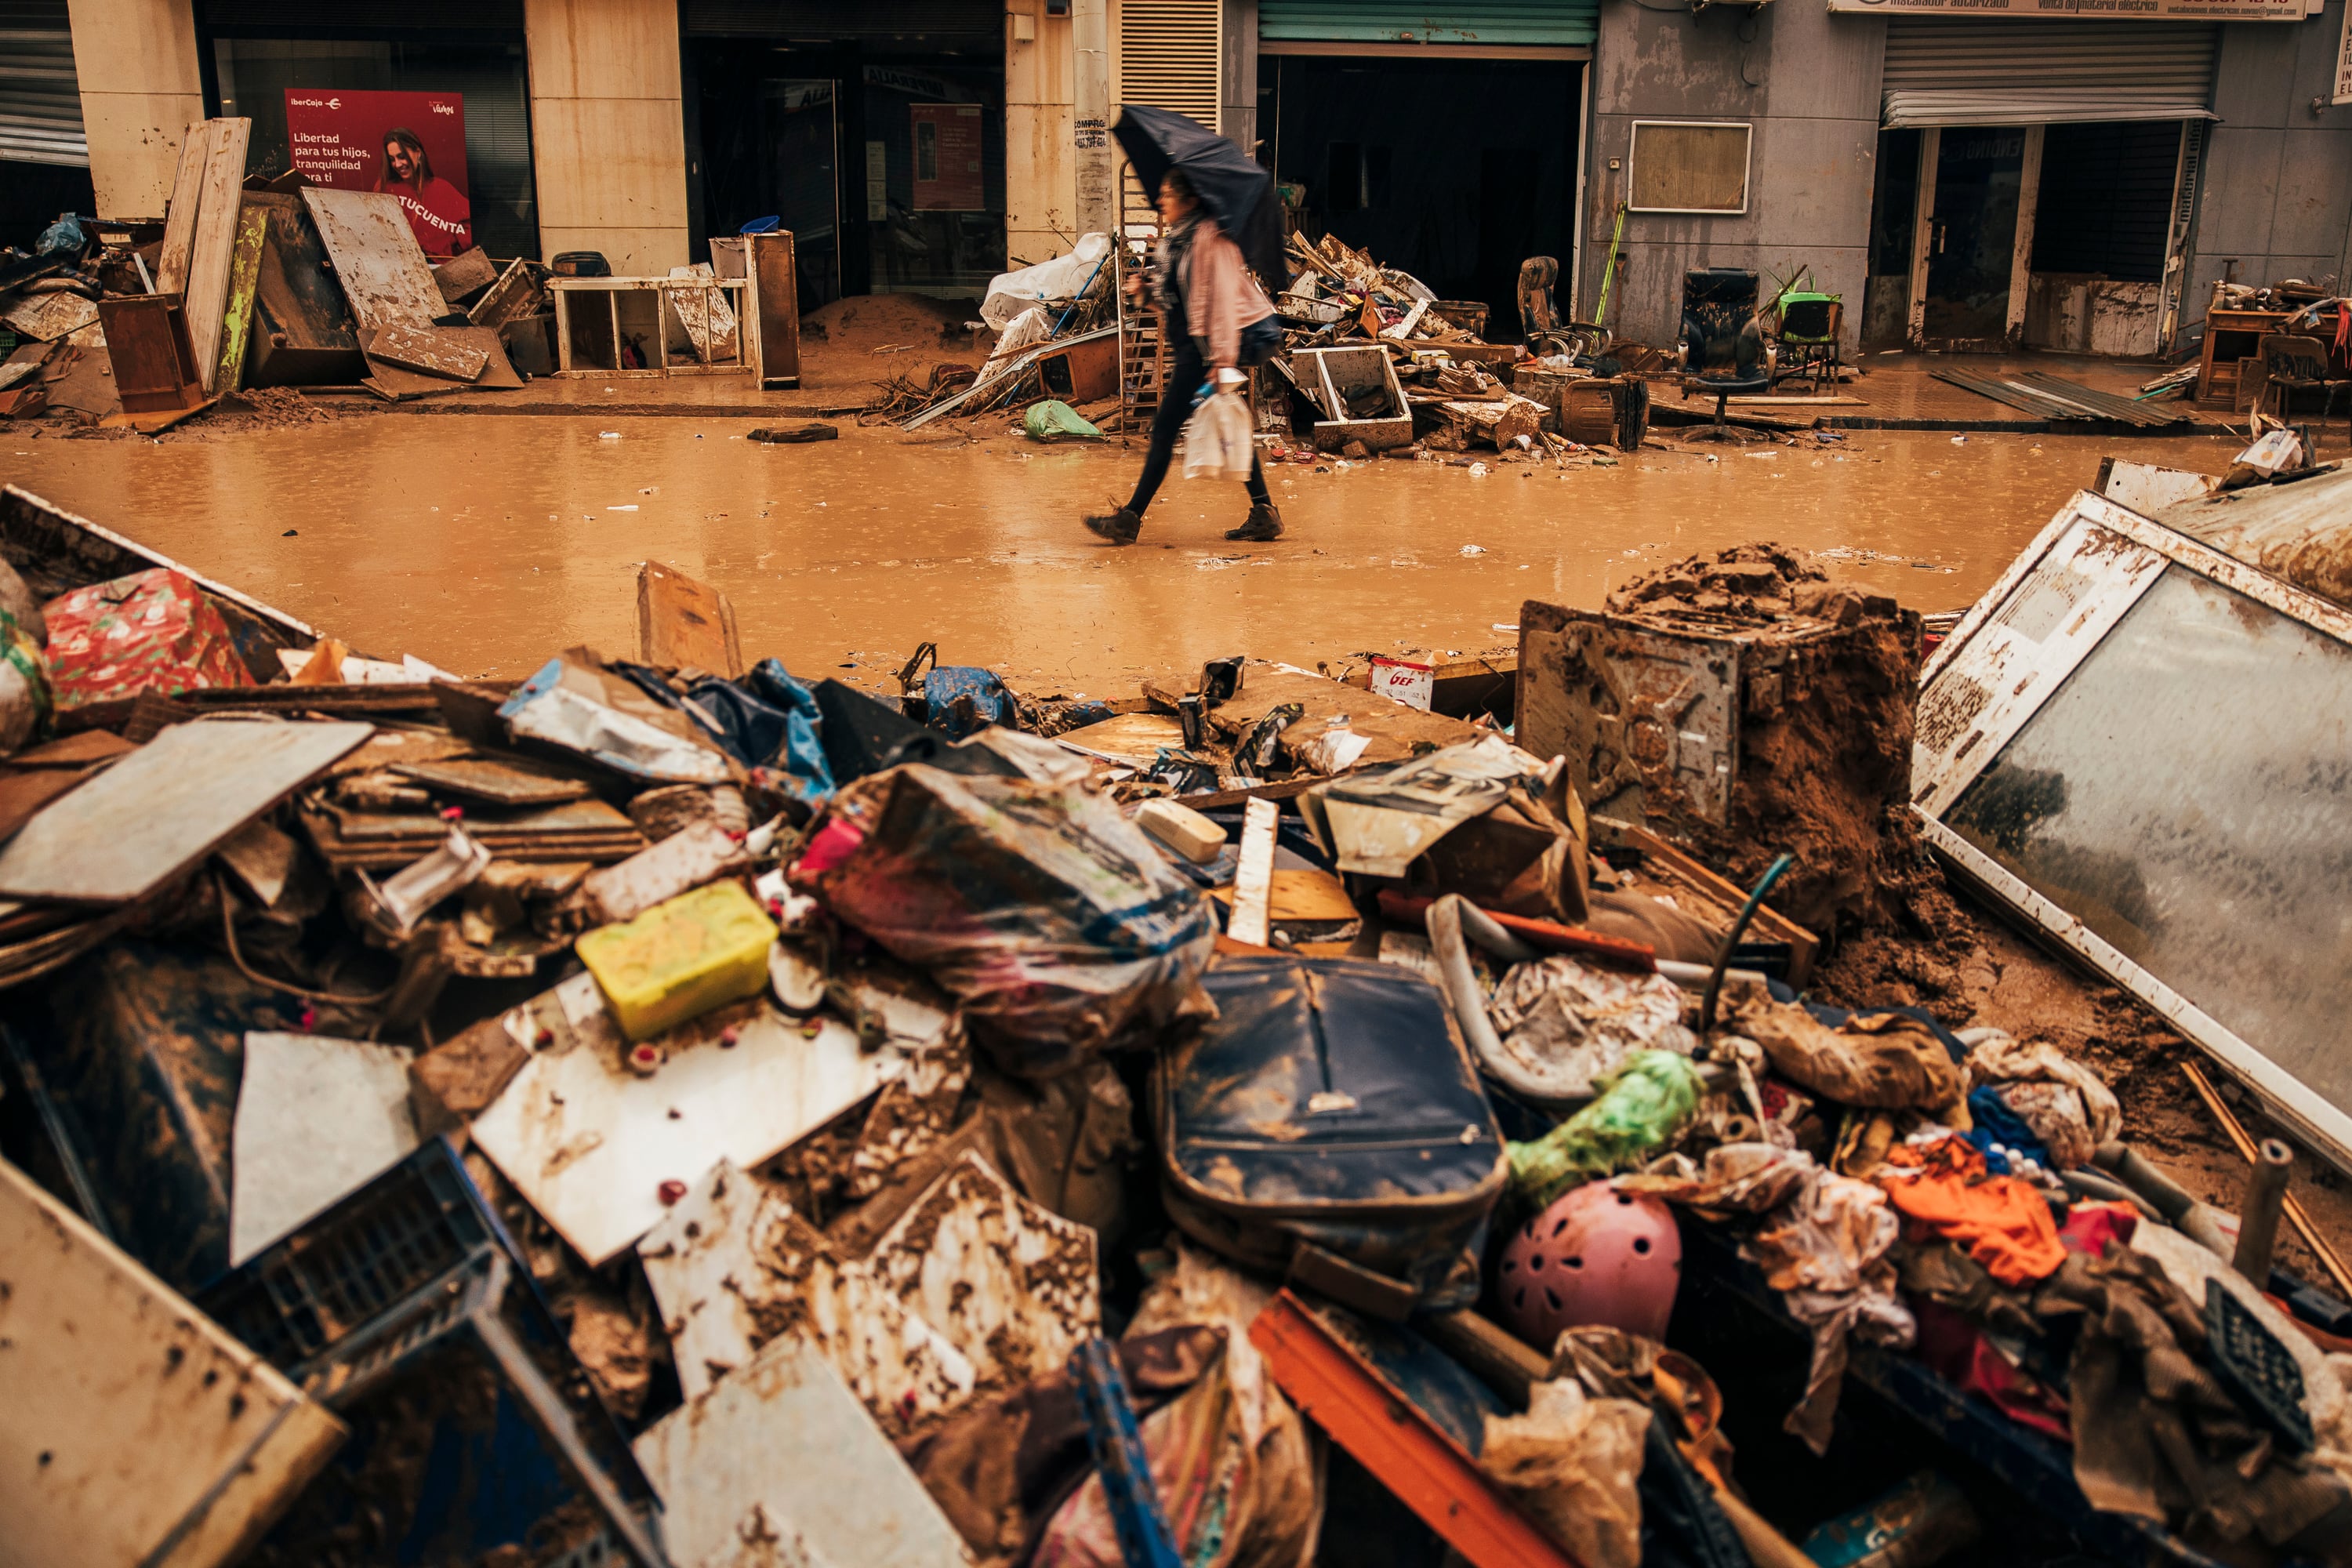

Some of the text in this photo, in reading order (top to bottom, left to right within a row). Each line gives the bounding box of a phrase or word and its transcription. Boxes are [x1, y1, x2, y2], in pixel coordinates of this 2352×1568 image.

[294, 132, 339, 143] Libertad
[295, 147, 371, 158] para tus hijos,
[296, 159, 361, 171] tranquilidad
[325, 172, 332, 182] ti
[2180, 155, 2198, 223] material
[1389, 670, 1415, 686] GEF
